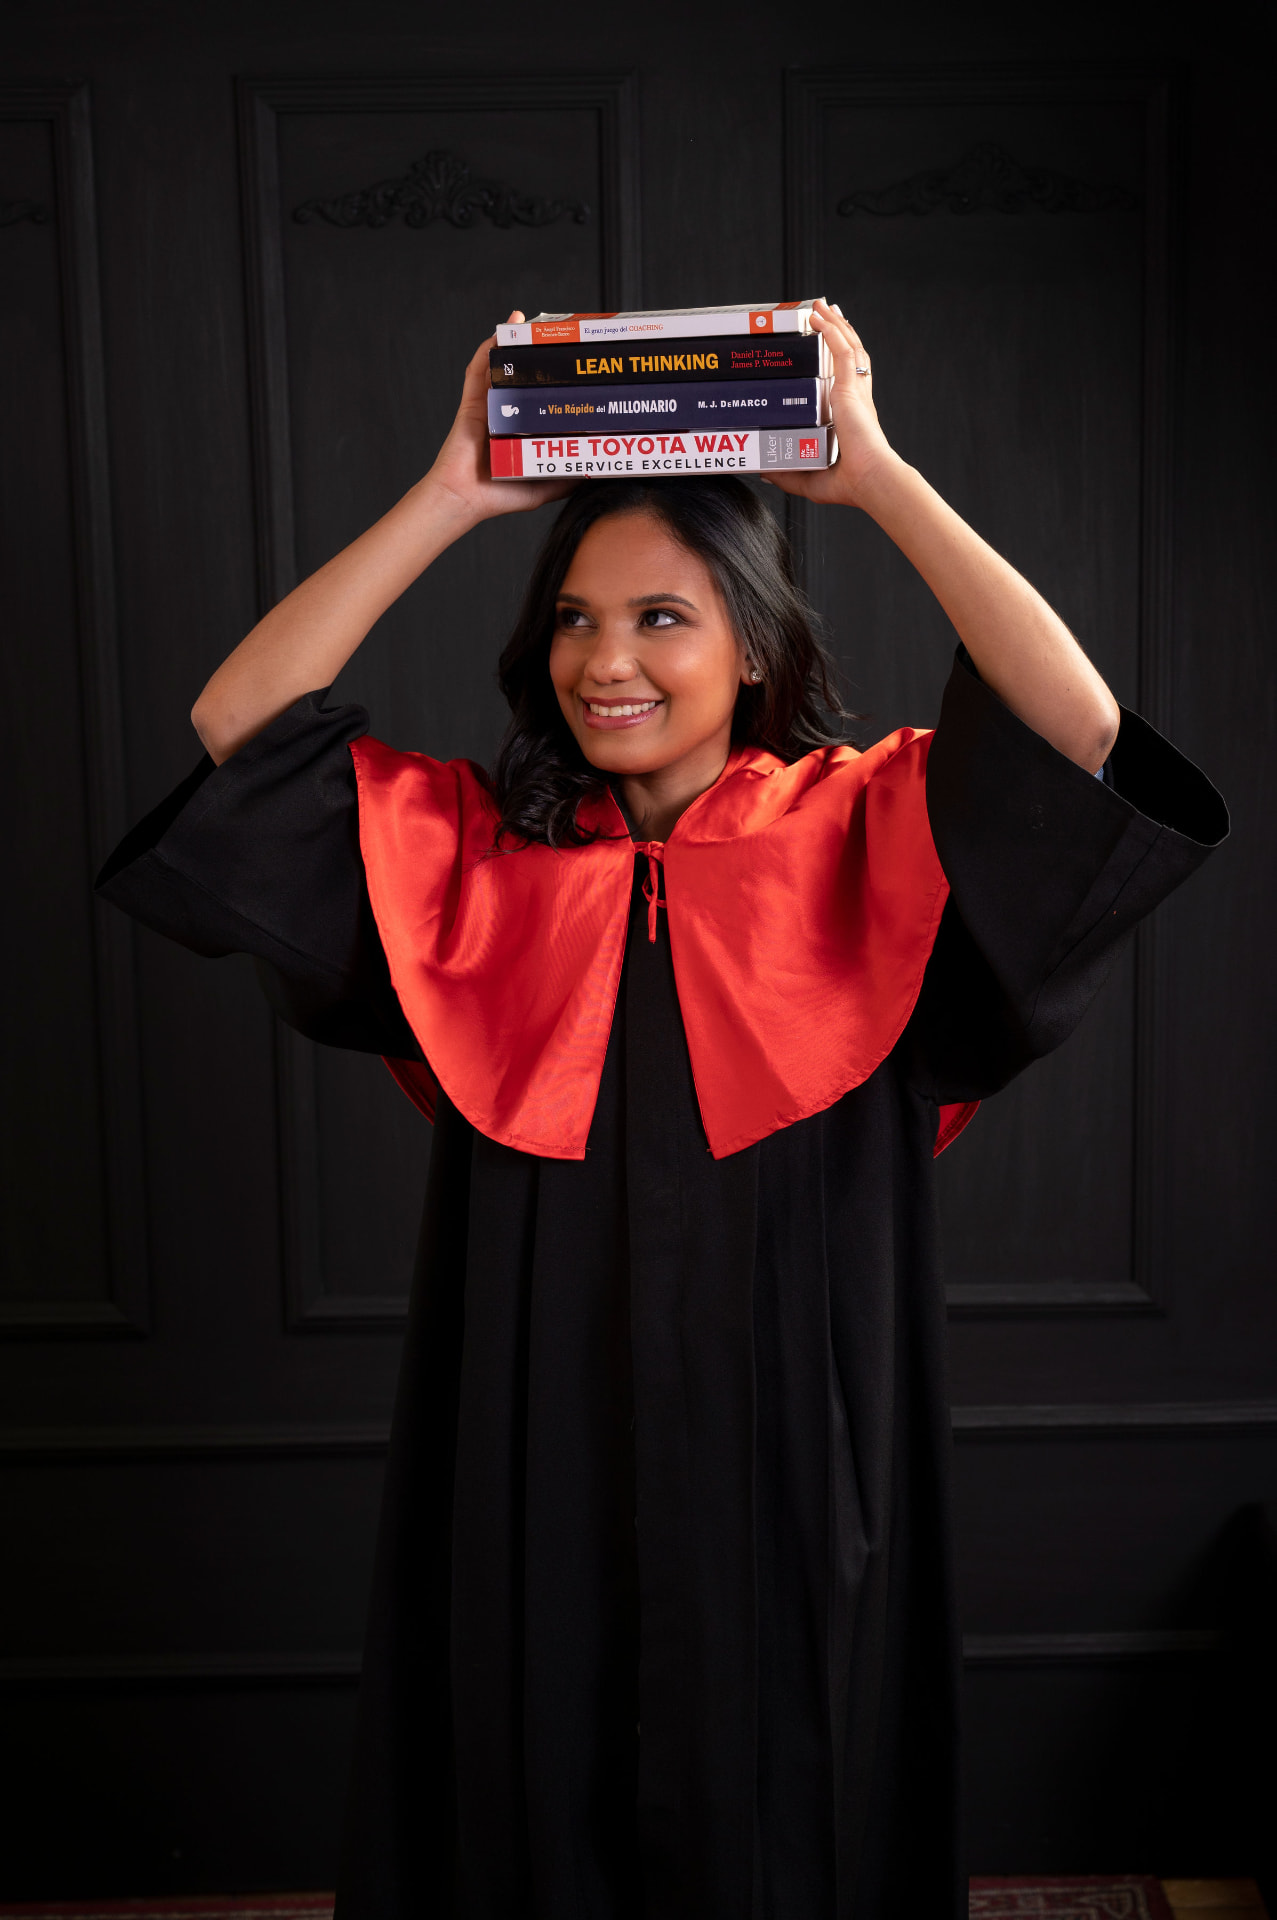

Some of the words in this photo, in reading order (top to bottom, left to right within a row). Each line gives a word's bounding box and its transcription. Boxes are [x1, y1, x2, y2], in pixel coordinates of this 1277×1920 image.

[591, 328, 604, 336] gran
[604, 326, 619, 335] juego
[628, 324, 664, 332] COACHING
[731, 350, 754, 359] Daniel
[755, 350, 762, 358] T.
[763, 349, 784, 358] Jones
[576, 357, 624, 375] LEAN
[628, 353, 719, 373] THINKING
[731, 361, 753, 369] James
[754, 360, 761, 368] P.
[763, 358, 793, 368] Womack
[539, 407, 547, 415] La
[548, 404, 563, 415] Vía
[564, 403, 595, 416] Rápida
[596, 405, 606, 413] del
[608, 399, 678, 414] MILLONARIO
[698, 401, 709, 409] M.
[531, 439, 580, 458] THE
[588, 436, 687, 457] TOYOTA
[693, 433, 750, 453] WAY
[767, 434, 777, 463] Liker
[784, 437, 793, 460] Ross
[536, 463, 557, 473] TO
[565, 460, 634, 473] SERVICE
[642, 457, 747, 470] EXCELLENCE
